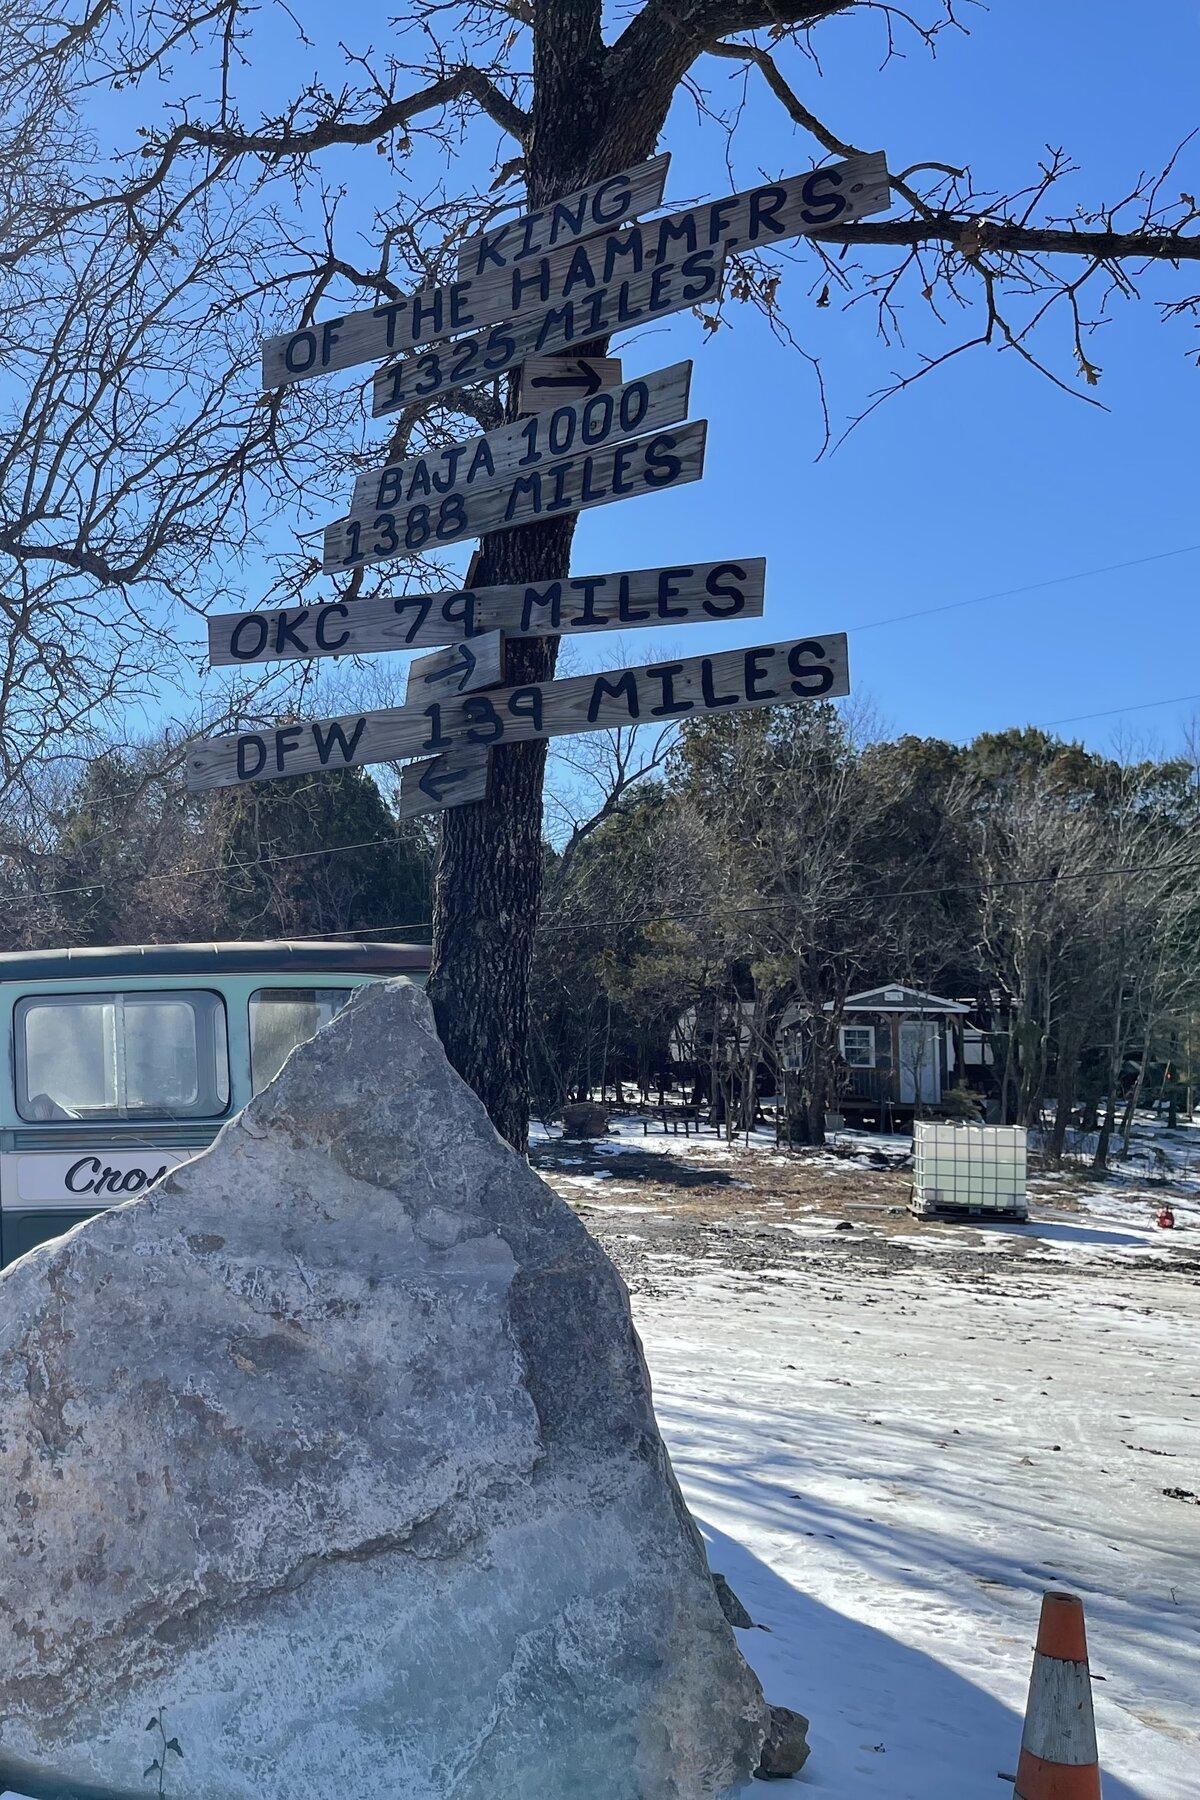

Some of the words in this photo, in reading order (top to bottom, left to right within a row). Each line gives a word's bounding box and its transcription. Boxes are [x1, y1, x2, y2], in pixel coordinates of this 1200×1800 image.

[477, 174, 633, 275] KING
[284, 317, 345, 375] OF
[372, 278, 475, 349] THE
[382, 334, 516, 404] 1325
[533, 247, 718, 350] MILES
[342, 495, 469, 566] 1388
[503, 433, 683, 521] MILES
[377, 446, 496, 511] BAJA
[519, 381, 649, 465] 1000
[229, 602, 351, 661] OKC
[394, 591, 477, 644] 79
[519, 563, 747, 632] MILES
[236, 716, 367, 781] DFW
[424, 686, 544, 750] 139
[587, 640, 835, 724] MILES
